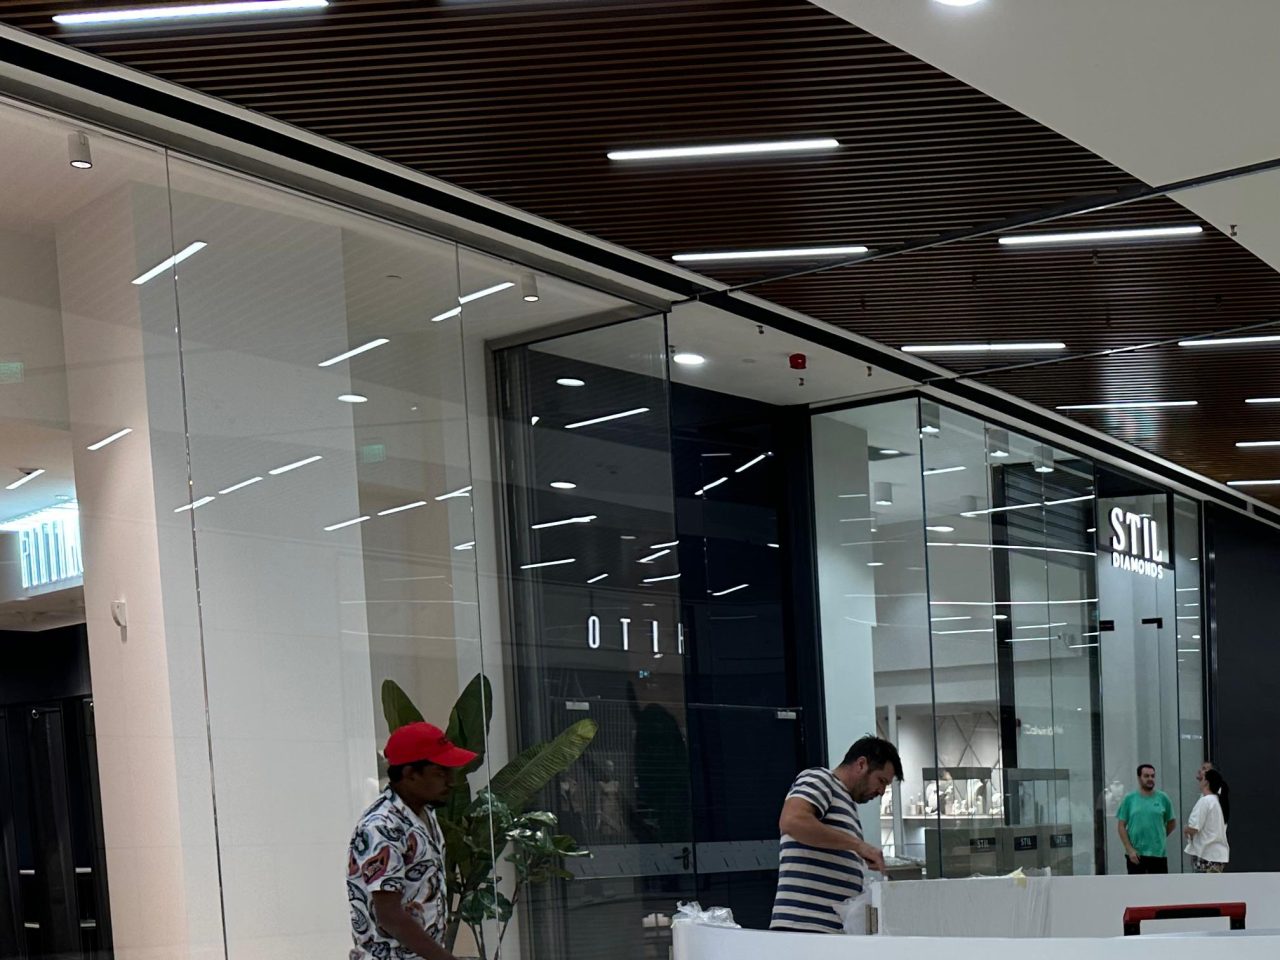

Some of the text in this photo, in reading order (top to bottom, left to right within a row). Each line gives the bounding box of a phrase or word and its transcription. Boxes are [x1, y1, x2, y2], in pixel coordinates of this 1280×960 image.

[1111, 506, 1163, 562] STIL
[1112, 551, 1164, 580] DIAMONDS
[1021, 837, 1032, 847] STIL
